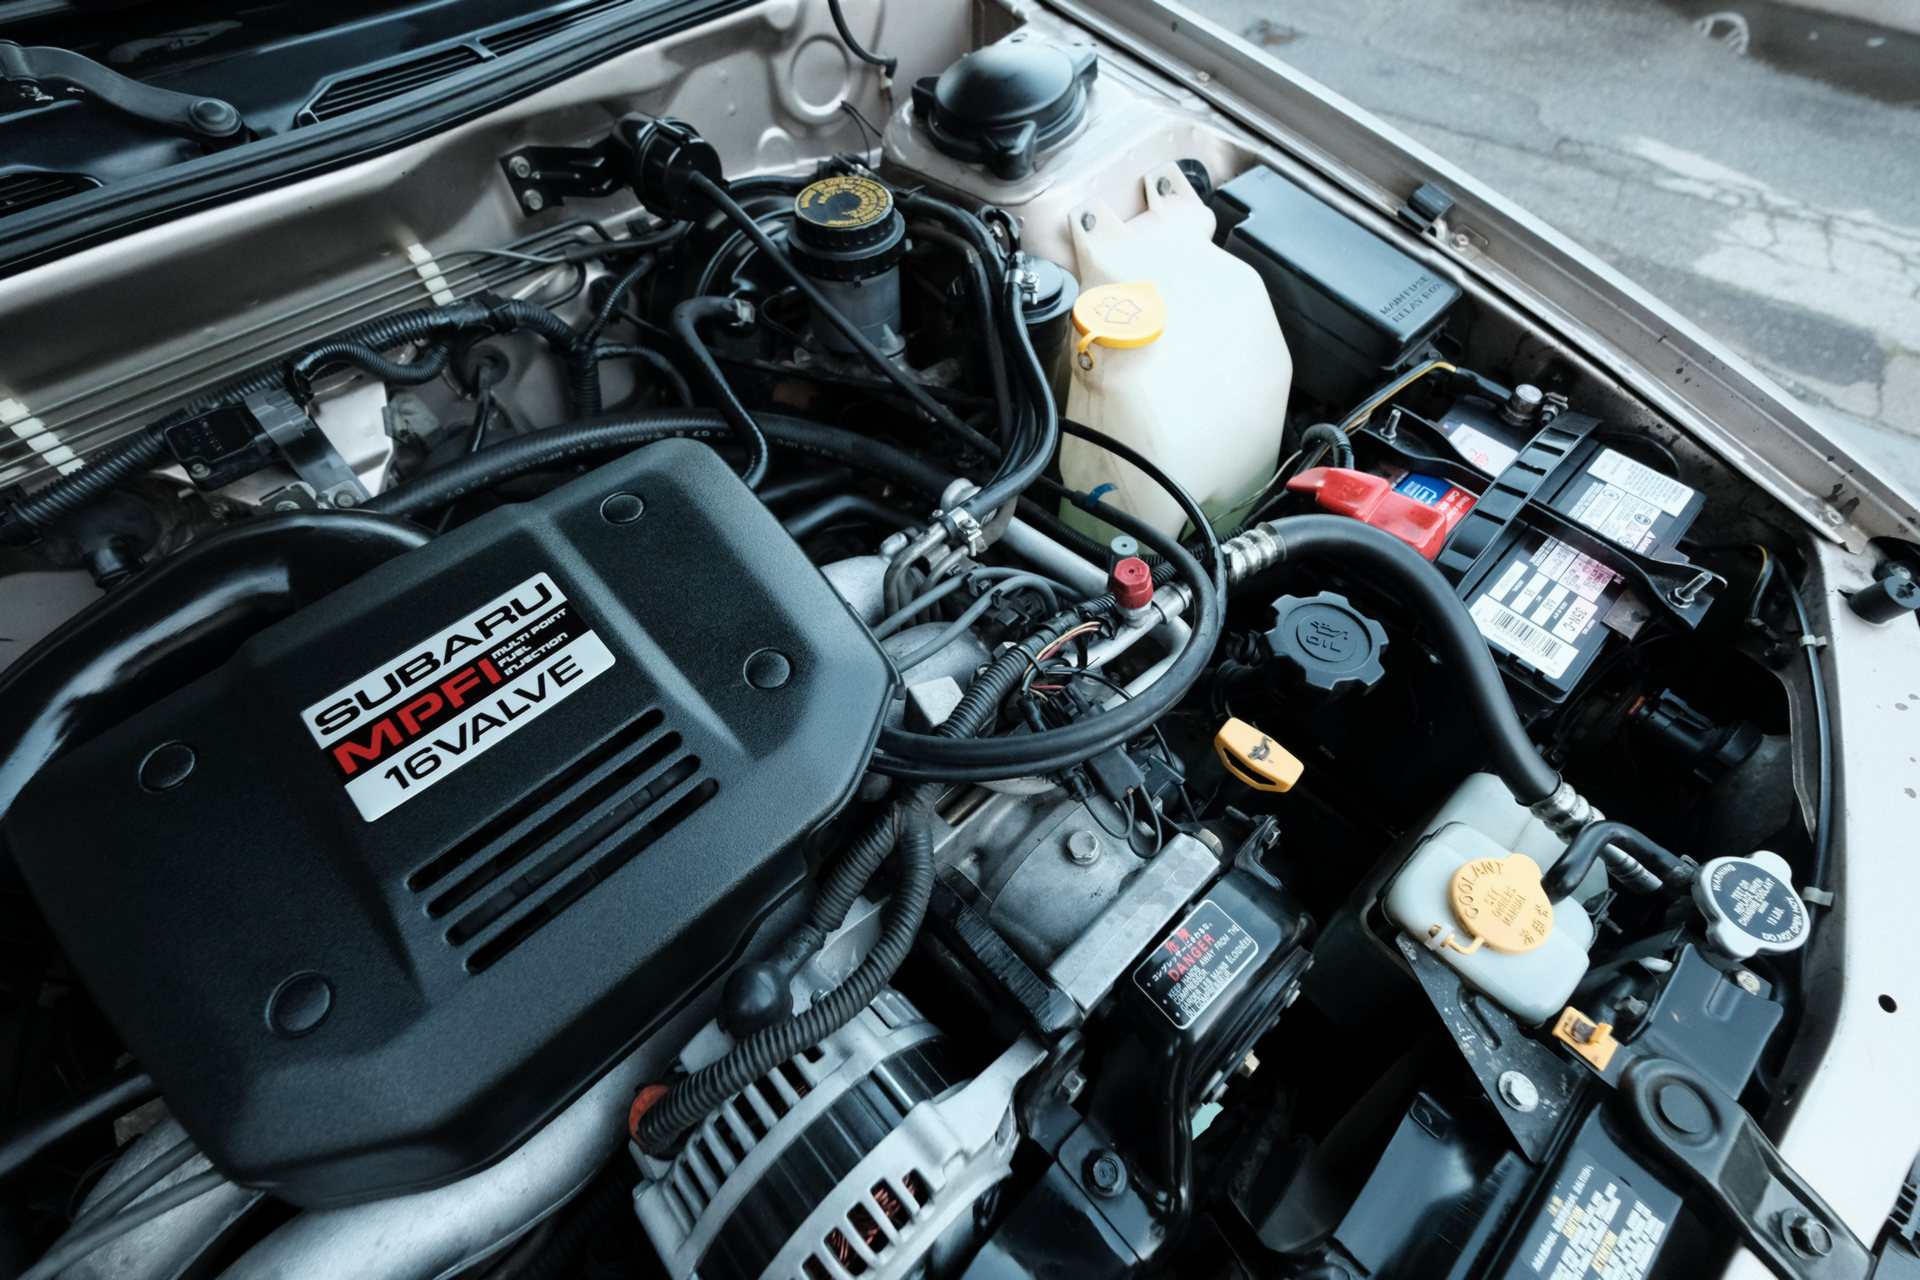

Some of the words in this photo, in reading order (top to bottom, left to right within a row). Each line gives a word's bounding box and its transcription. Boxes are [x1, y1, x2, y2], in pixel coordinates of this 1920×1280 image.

[1392, 298, 1423, 323] RELAY
[491, 630, 529, 660] MULTI
[530, 607, 568, 636] POINT
[498, 643, 532, 668] FUEL
[503, 631, 569, 677] INJECTION
[1306, 635, 1341, 653] OIL
[315, 582, 553, 735] SUBARU
[333, 658, 503, 774] MPFI
[1458, 861, 1503, 919] COOLANT
[1711, 863, 1736, 891] WARNING
[1776, 930, 1793, 943] NOT
[1789, 914, 1803, 934] OPEN
[1167, 933, 1216, 981] DANGER
[1167, 983, 1183, 1000] KEEP
[1181, 965, 1200, 984] HANDS
[1198, 949, 1216, 967] AWAY
[1214, 933, 1231, 951] FROM
[1228, 924, 1240, 936] THE
